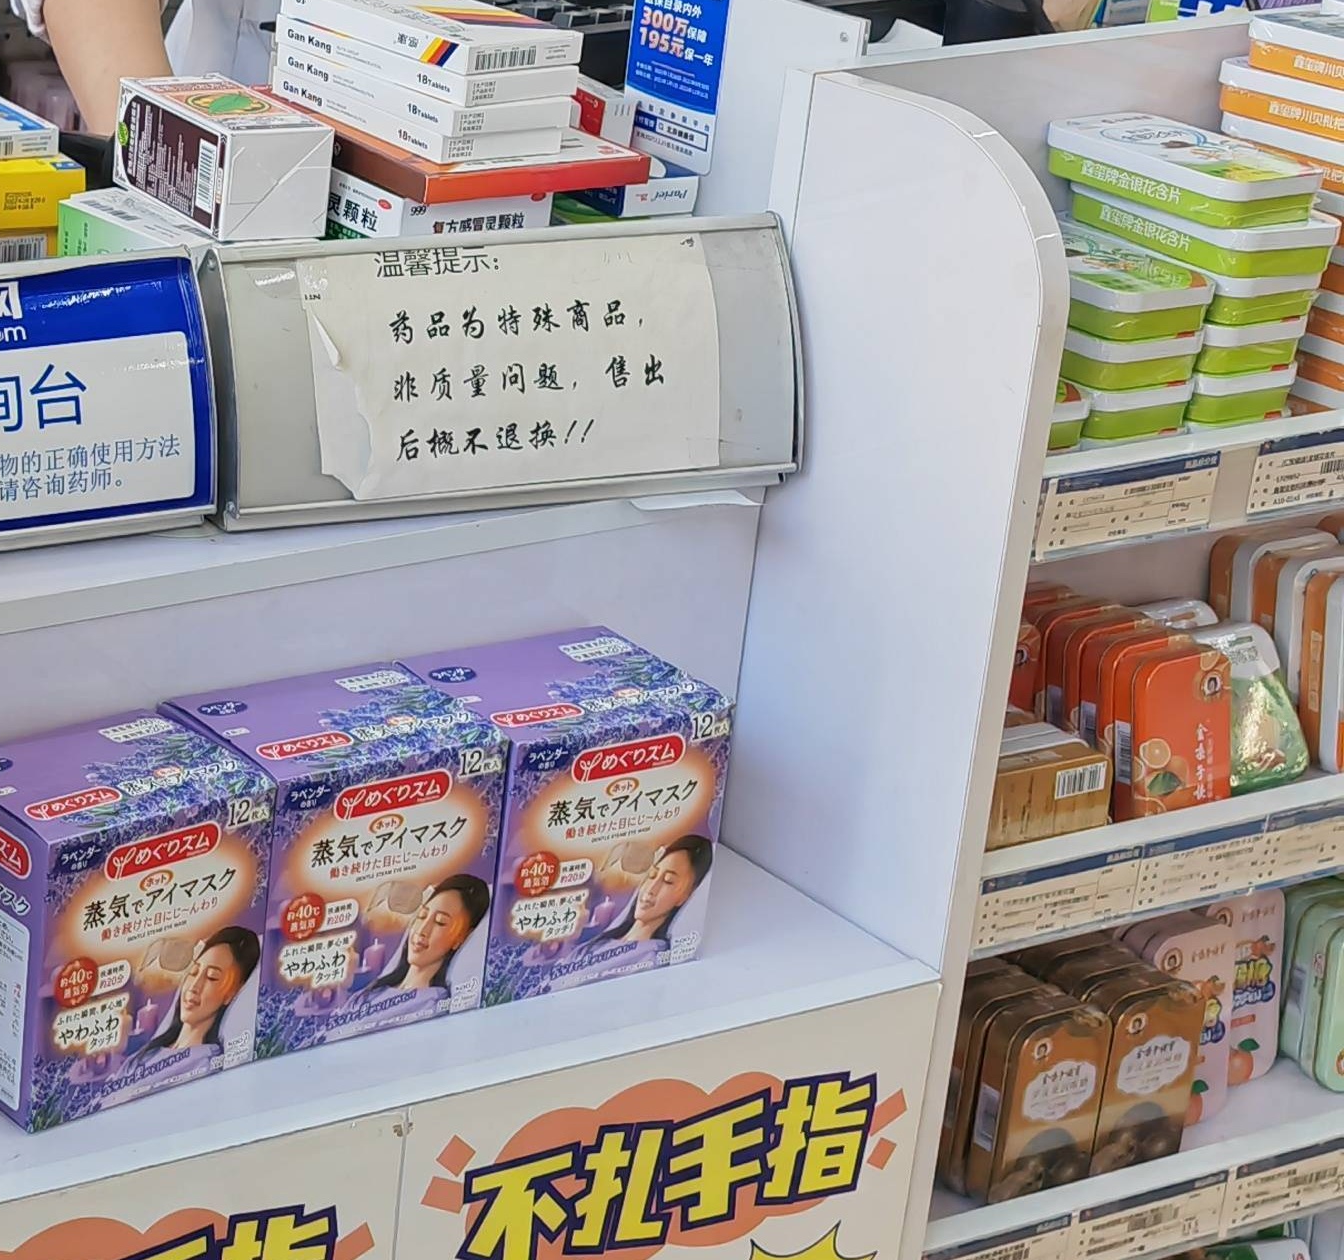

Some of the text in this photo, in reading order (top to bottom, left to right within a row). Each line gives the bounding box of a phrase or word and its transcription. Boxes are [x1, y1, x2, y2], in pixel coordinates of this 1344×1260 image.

[286, 28, 333, 55] Gan Kang
[287, 56, 330, 82] Gan Kang
[282, 80, 324, 108] Gan Kang
[410, 205, 427, 217] 999
[527, 747, 570, 765] ラベンダー
[601, 745, 677, 772] めぐりズム
[288, 784, 332, 803] ラベンダー
[366, 780, 442, 809] めぐりズム
[547, 778, 699, 828] 蒸気でアイマスク
[135, 830, 212, 866] めぐりズム
[311, 815, 468, 867] 蒸気でアイマスク
[59, 845, 102, 865] ラベンダー
[145, 874, 167, 888] ホット
[82, 866, 237, 932] 蒸気でアイマスク
[515, 907, 578, 931] やわふわ
[283, 950, 347, 977] やわふわ
[57, 1015, 120, 1046] やわふわ
[468, 1070, 874, 1260] 不扎手指
